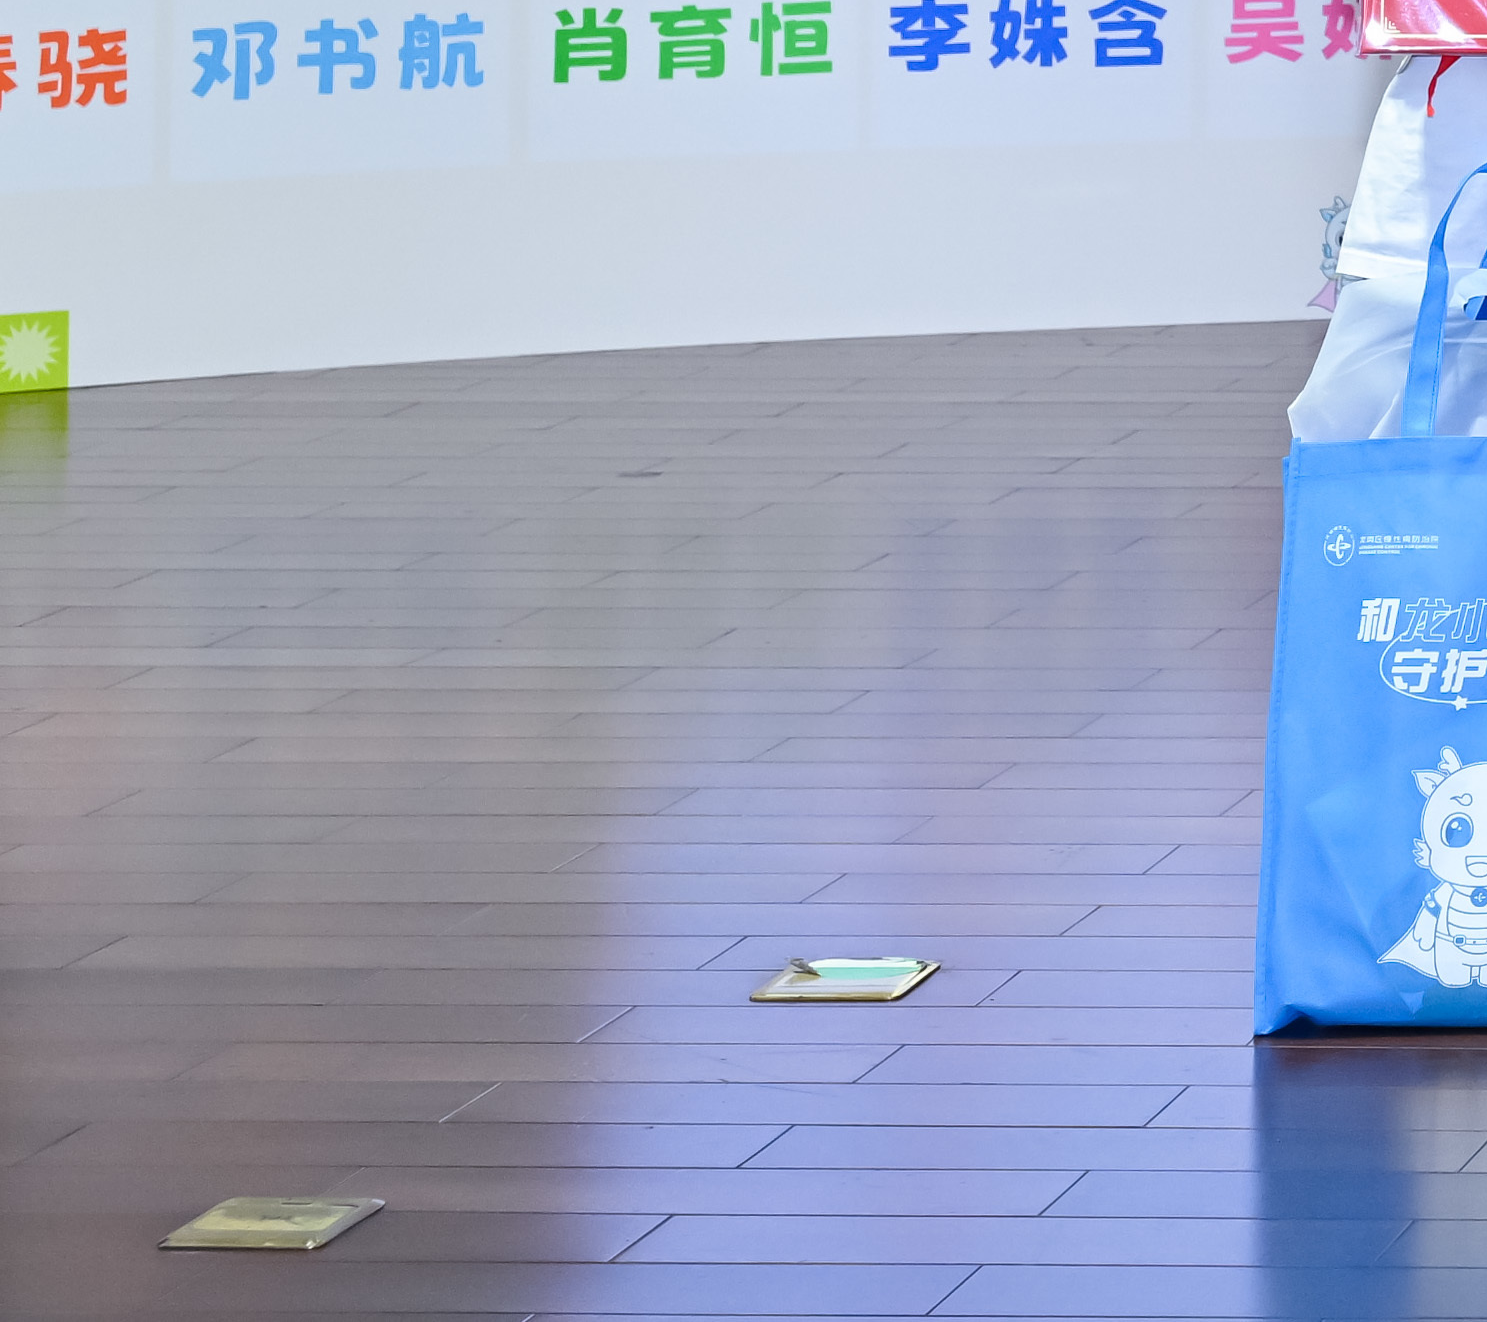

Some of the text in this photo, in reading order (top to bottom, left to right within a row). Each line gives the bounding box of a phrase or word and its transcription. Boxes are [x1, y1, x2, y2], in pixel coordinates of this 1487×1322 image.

[0, 29, 128, 112] 骁
[192, 13, 485, 101] 邓书航
[553, 1, 834, 84] 肖育恒
